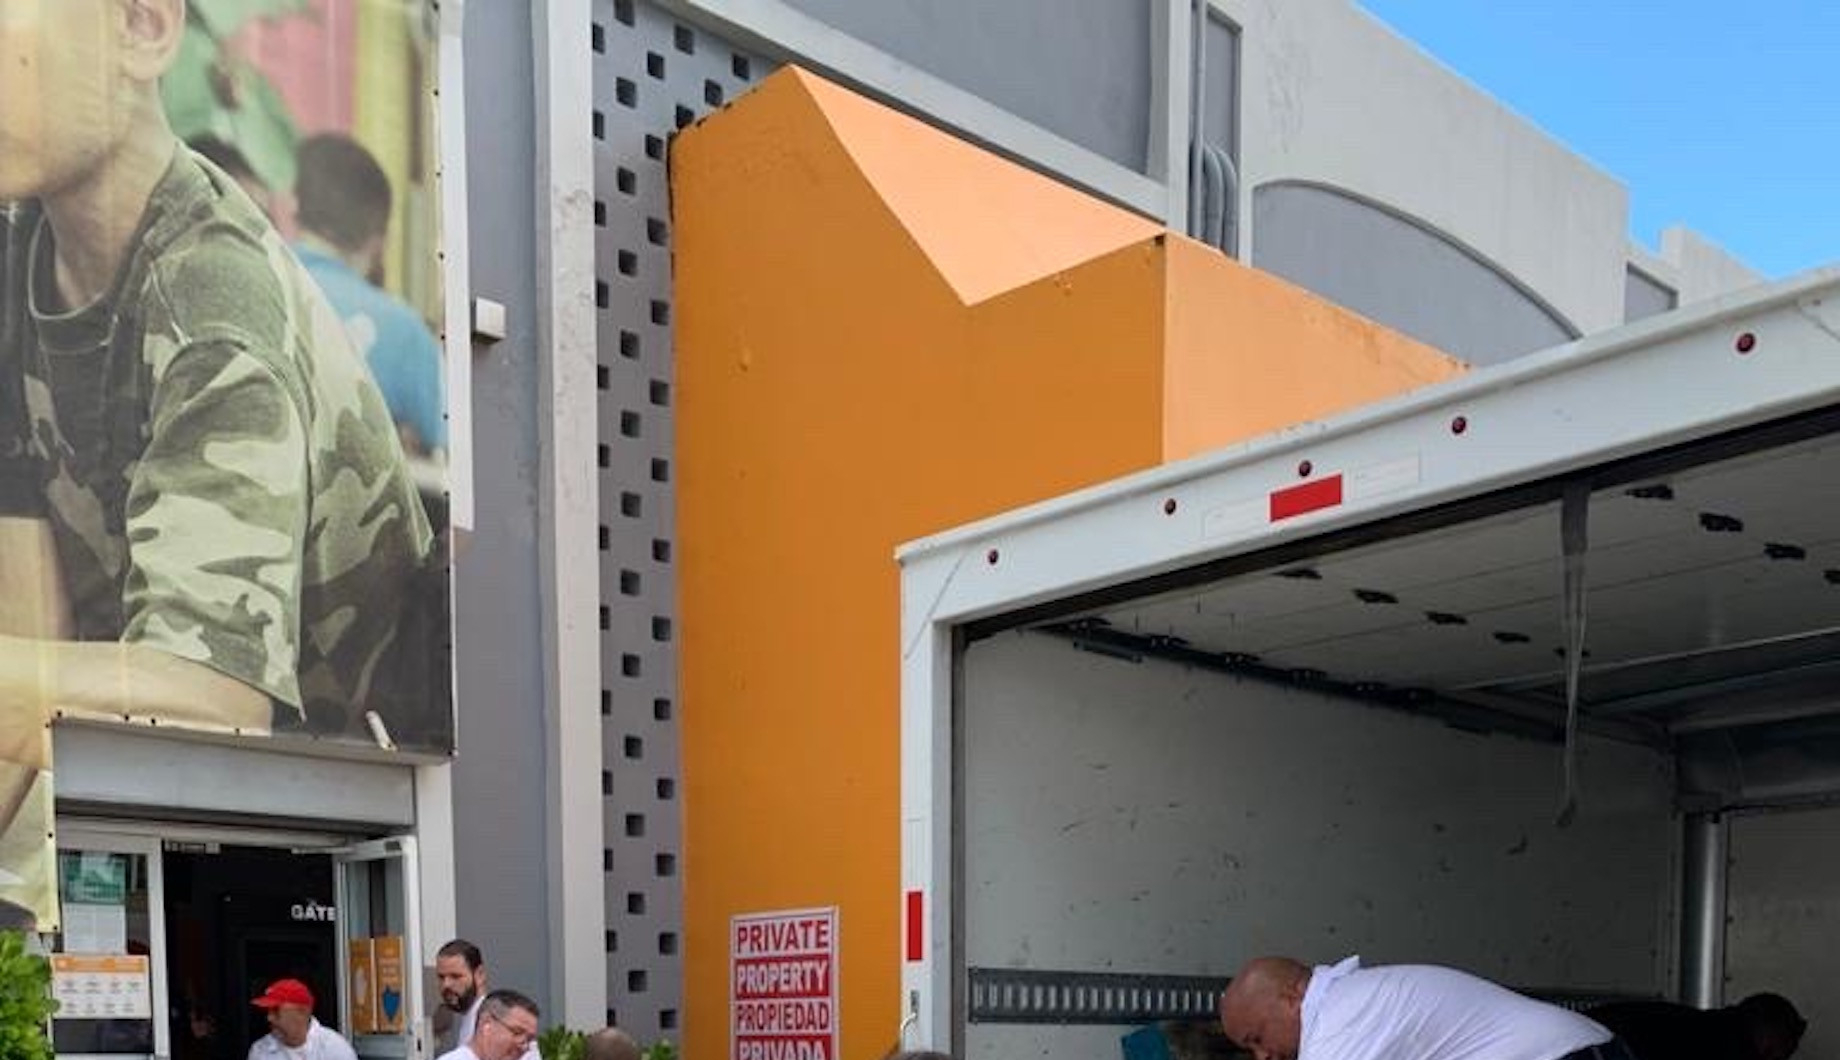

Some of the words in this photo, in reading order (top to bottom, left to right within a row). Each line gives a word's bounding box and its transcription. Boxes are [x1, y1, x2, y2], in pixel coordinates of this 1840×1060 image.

[737, 919, 829, 953] PRIVATE
[737, 961, 828, 992] PROPERTY
[736, 1002, 830, 1031] PROPIEDAD
